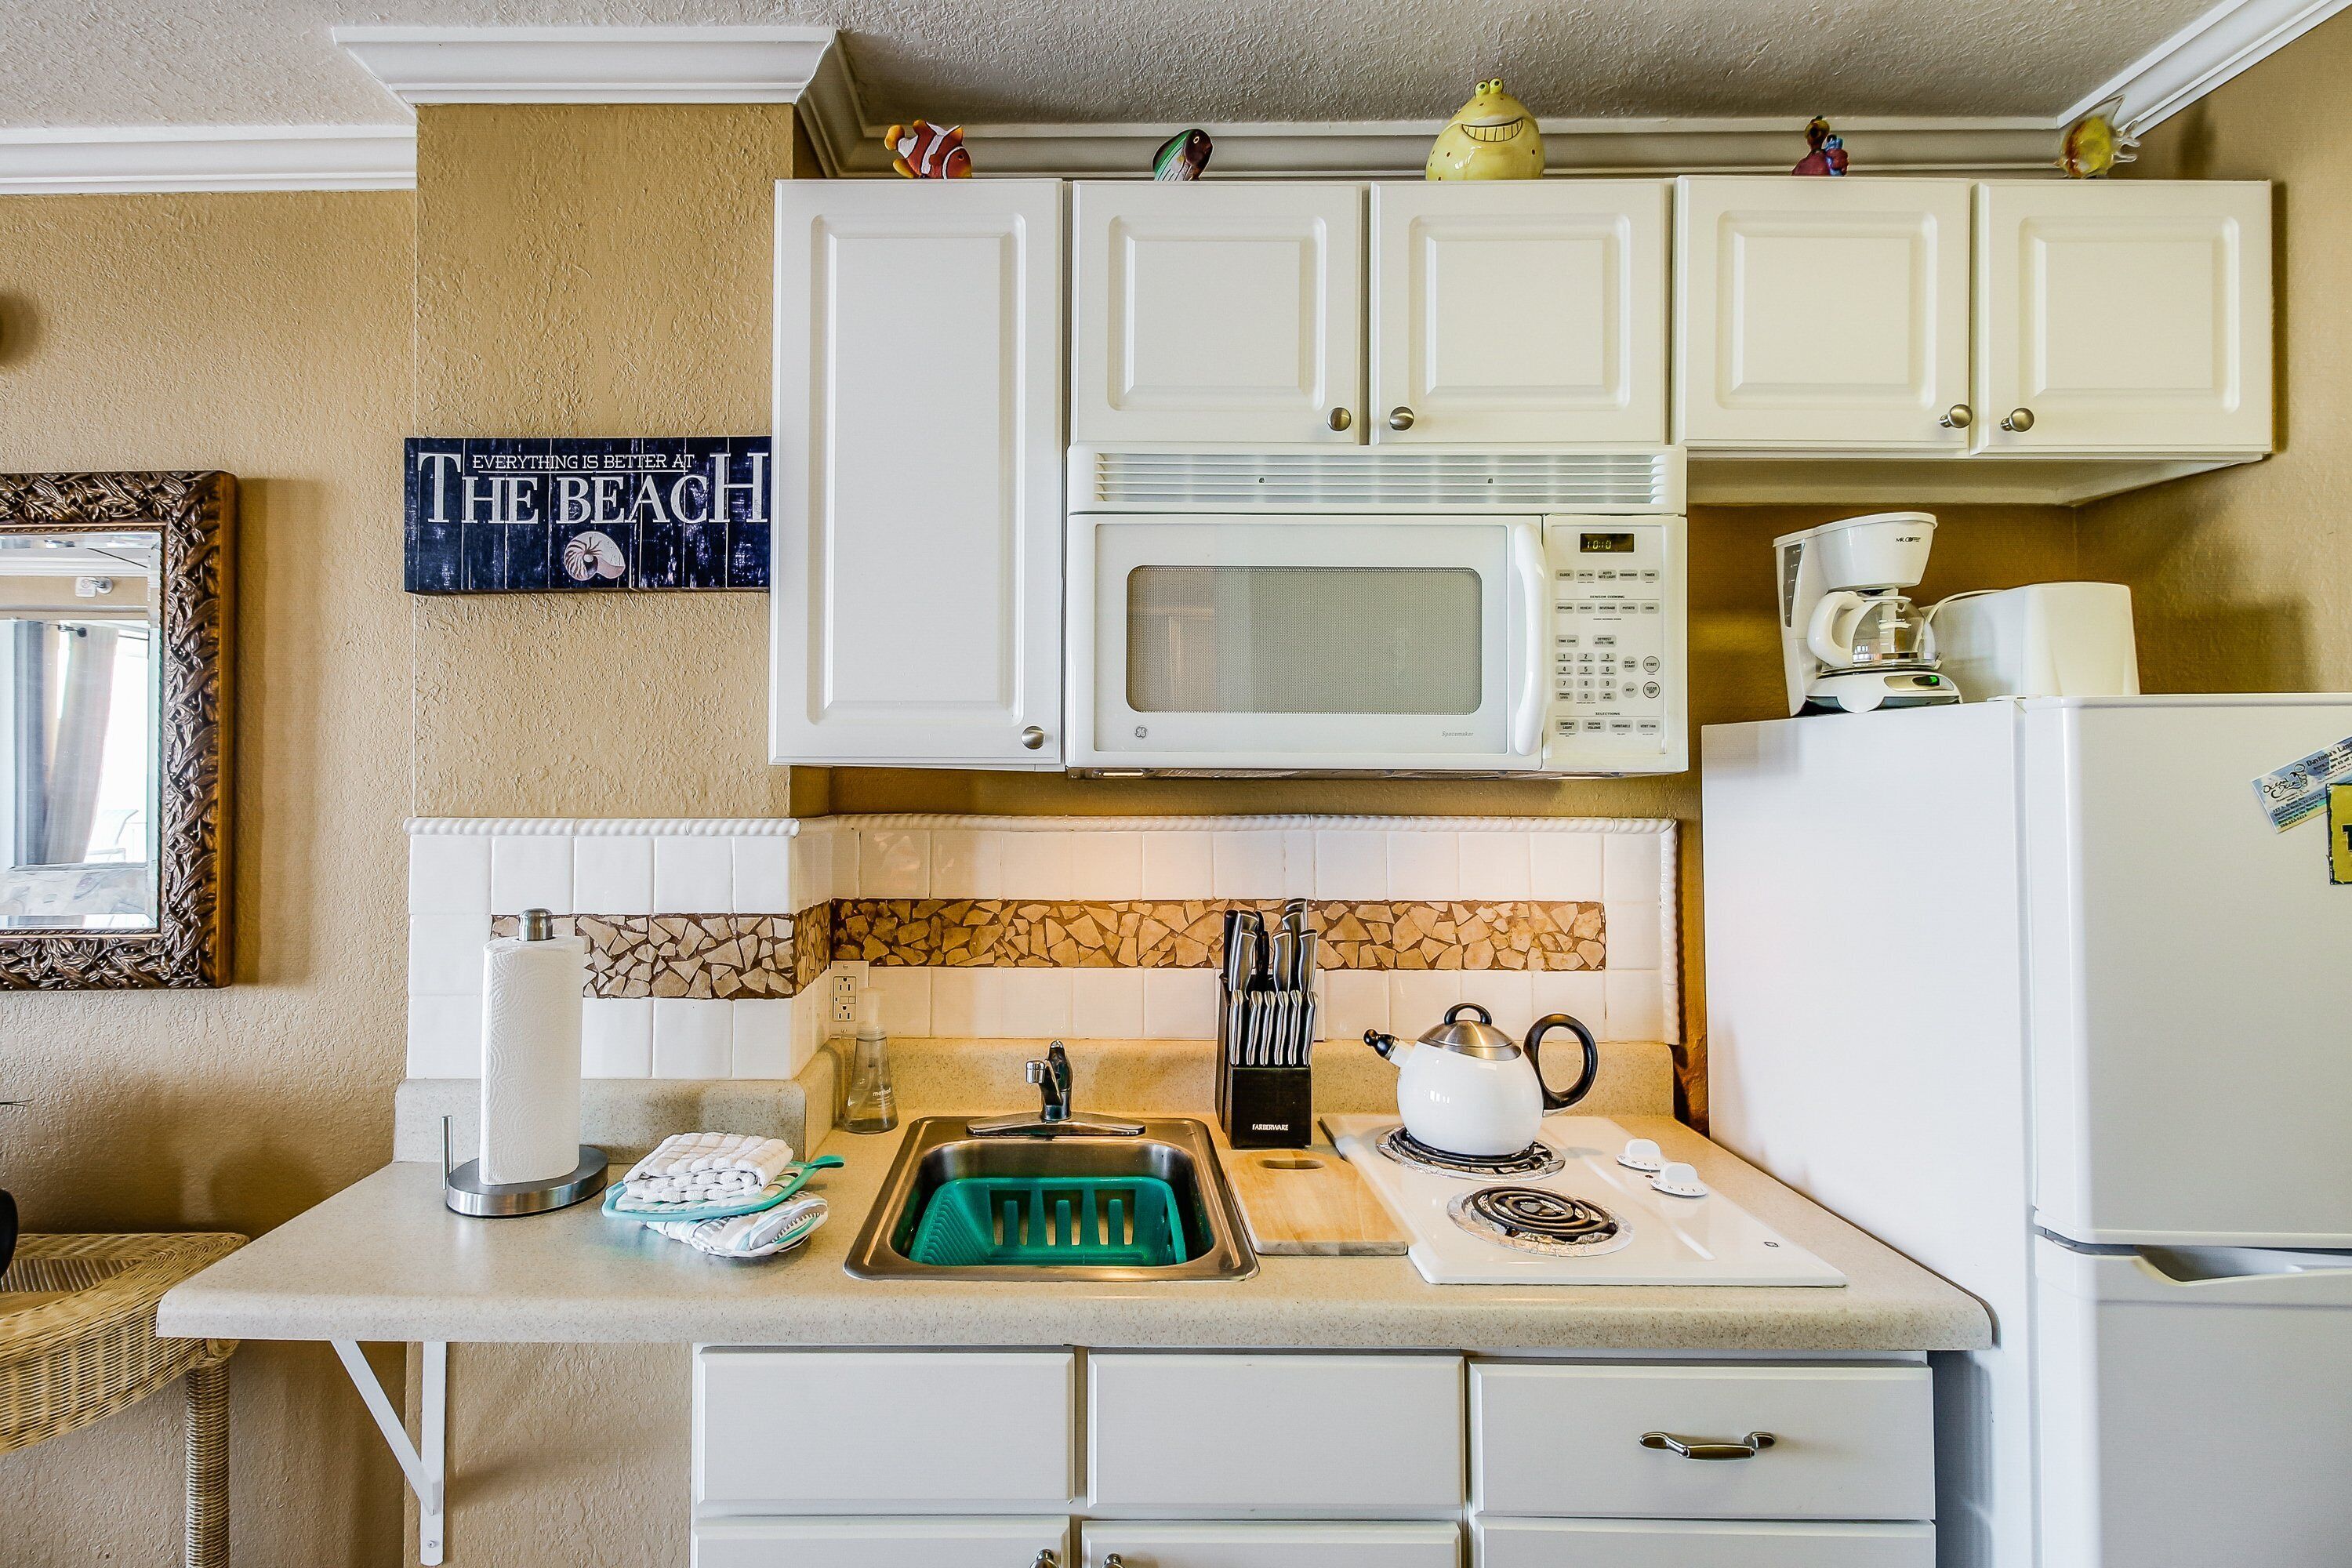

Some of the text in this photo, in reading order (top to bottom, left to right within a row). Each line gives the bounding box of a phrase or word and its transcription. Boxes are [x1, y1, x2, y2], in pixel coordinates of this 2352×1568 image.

[472, 454, 695, 470] EVERYTHING IS BETTER AT
[418, 452, 768, 524] THE BEACH
[1587, 540, 1612, 550] 10:10
